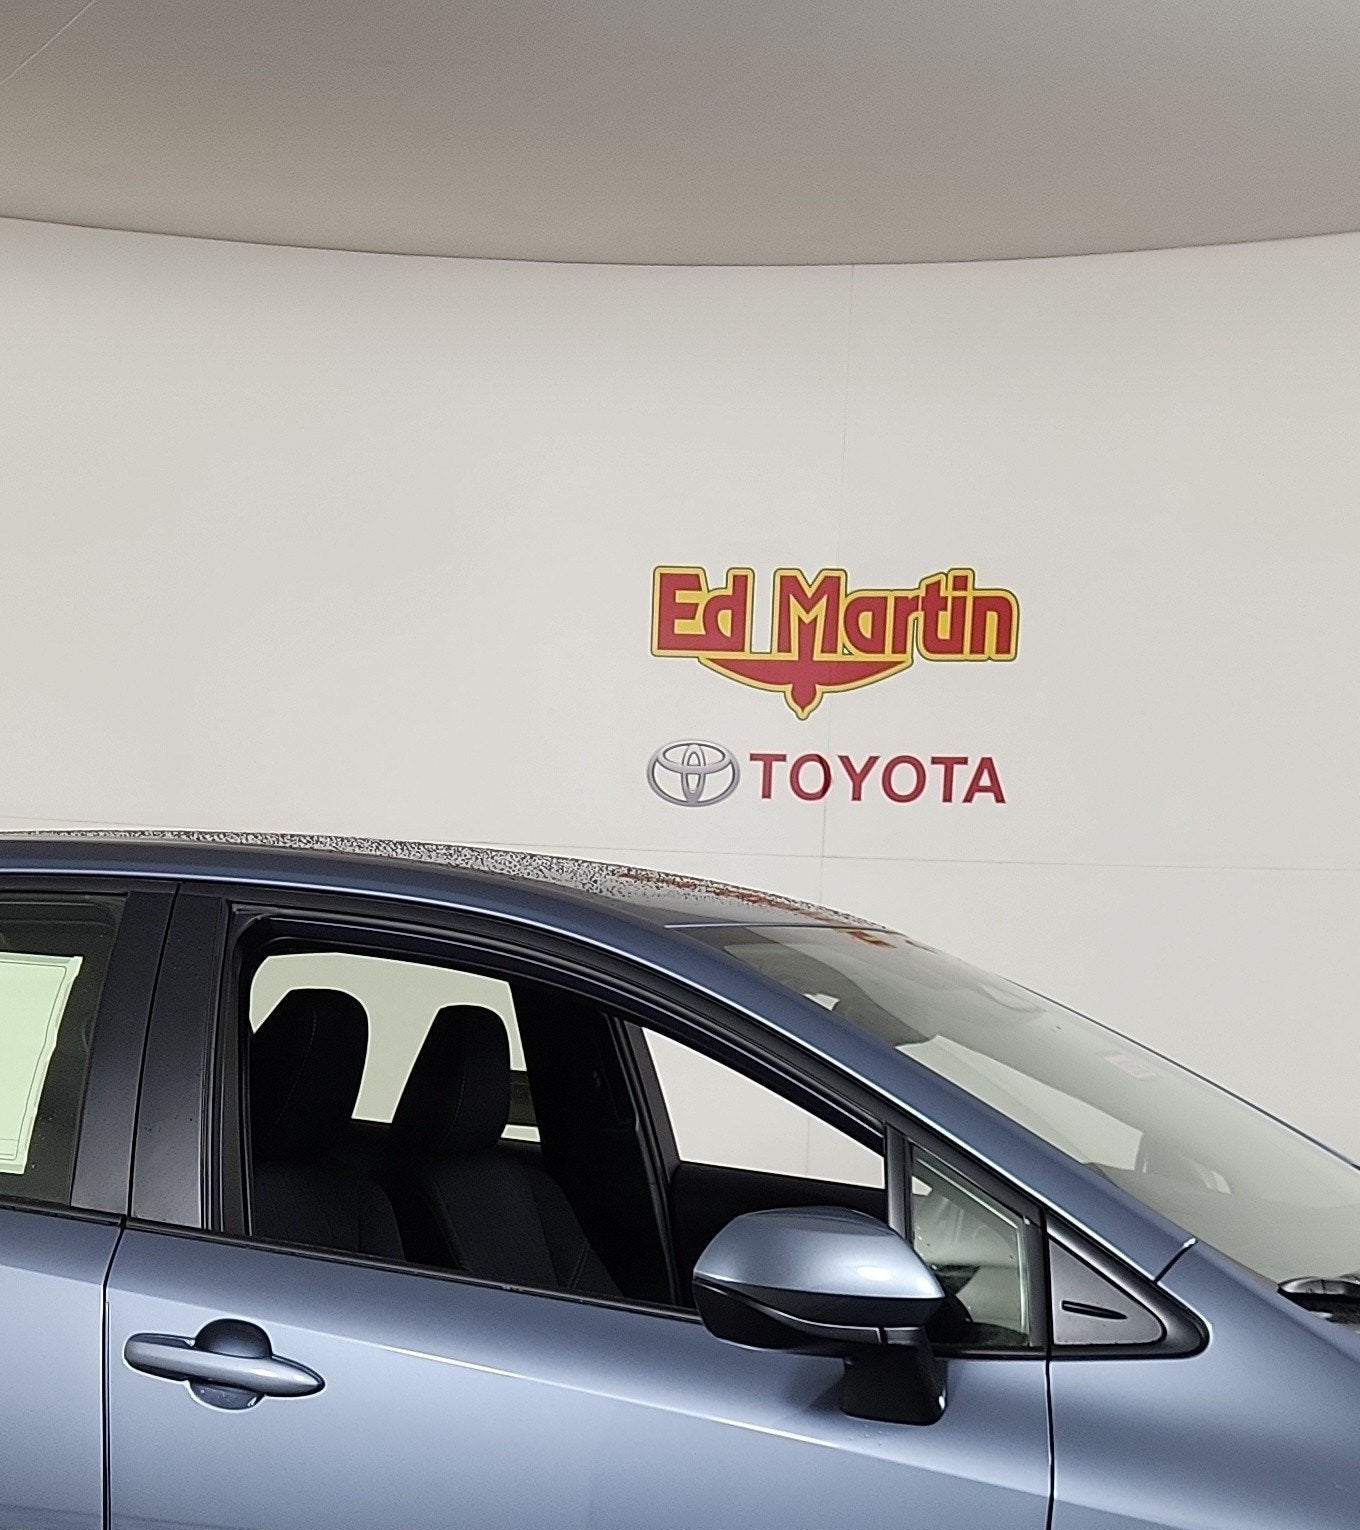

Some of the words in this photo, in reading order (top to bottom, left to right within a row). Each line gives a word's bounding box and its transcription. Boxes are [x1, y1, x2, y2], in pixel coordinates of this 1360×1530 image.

[656, 572, 748, 653] Ed
[777, 572, 1015, 656] Martin
[749, 753, 1006, 804] TOYOTA
